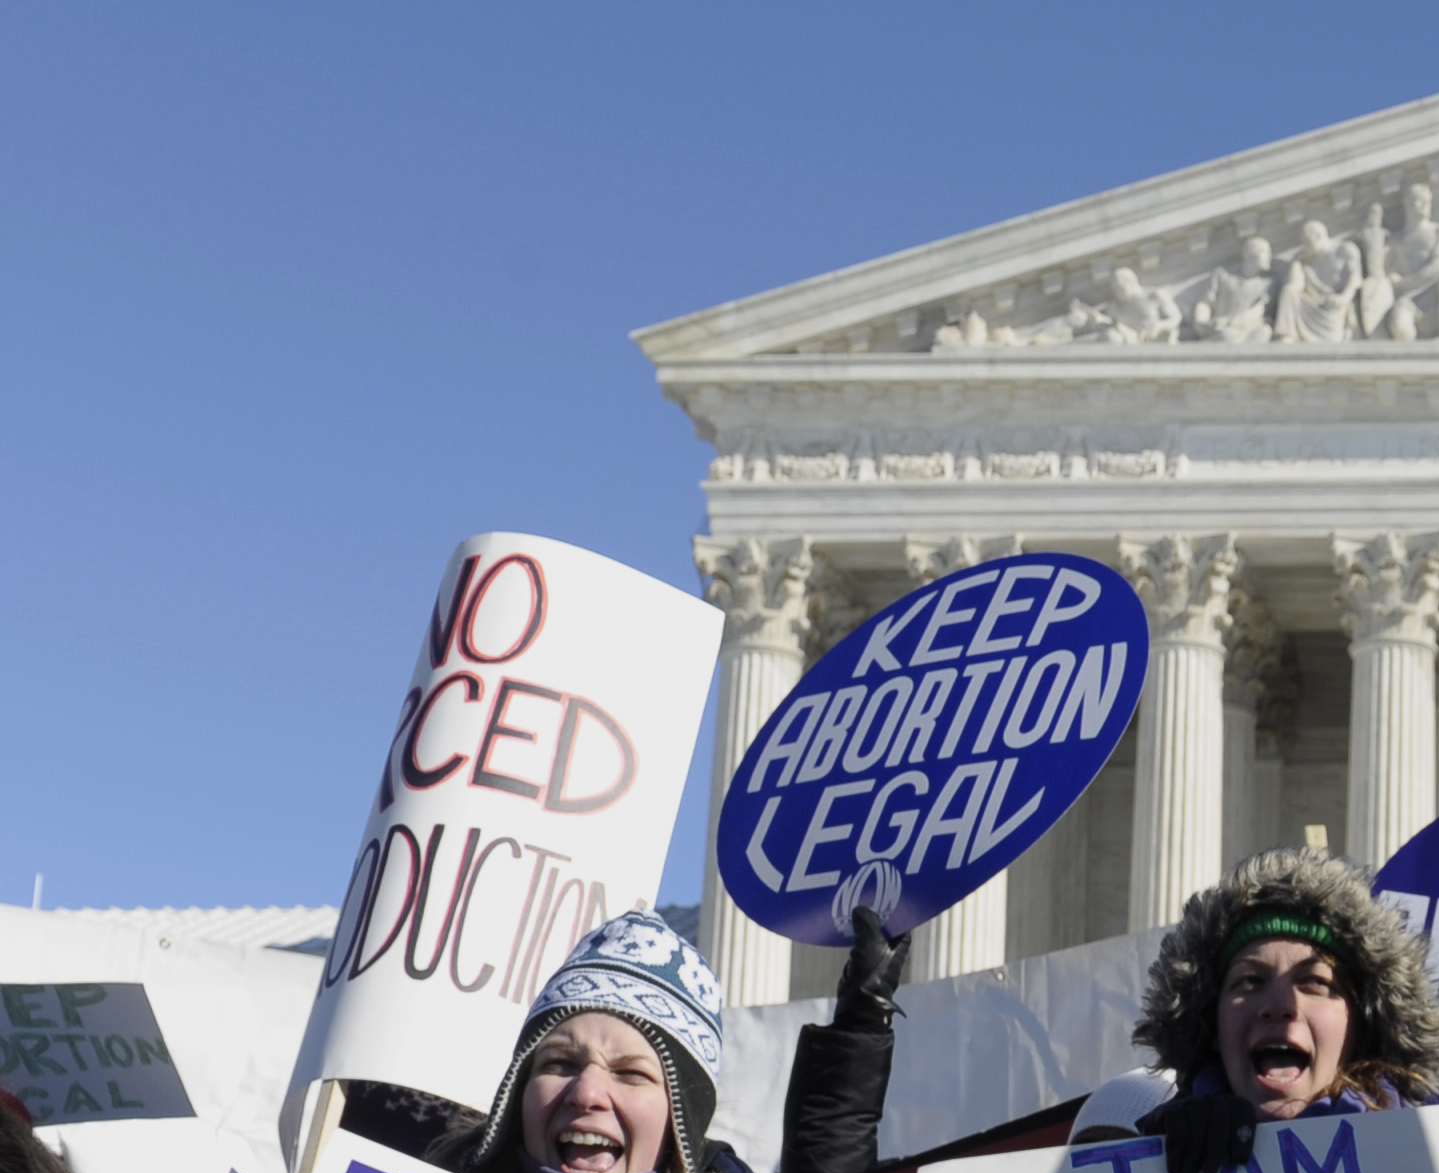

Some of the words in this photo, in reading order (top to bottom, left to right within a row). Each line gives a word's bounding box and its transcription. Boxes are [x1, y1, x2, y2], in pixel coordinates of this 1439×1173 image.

[429, 553, 548, 670] NO
[852, 565, 1101, 678] KEEP
[747, 642, 1127, 793] ABORTION
[746, 758, 1046, 893] LEGAL
